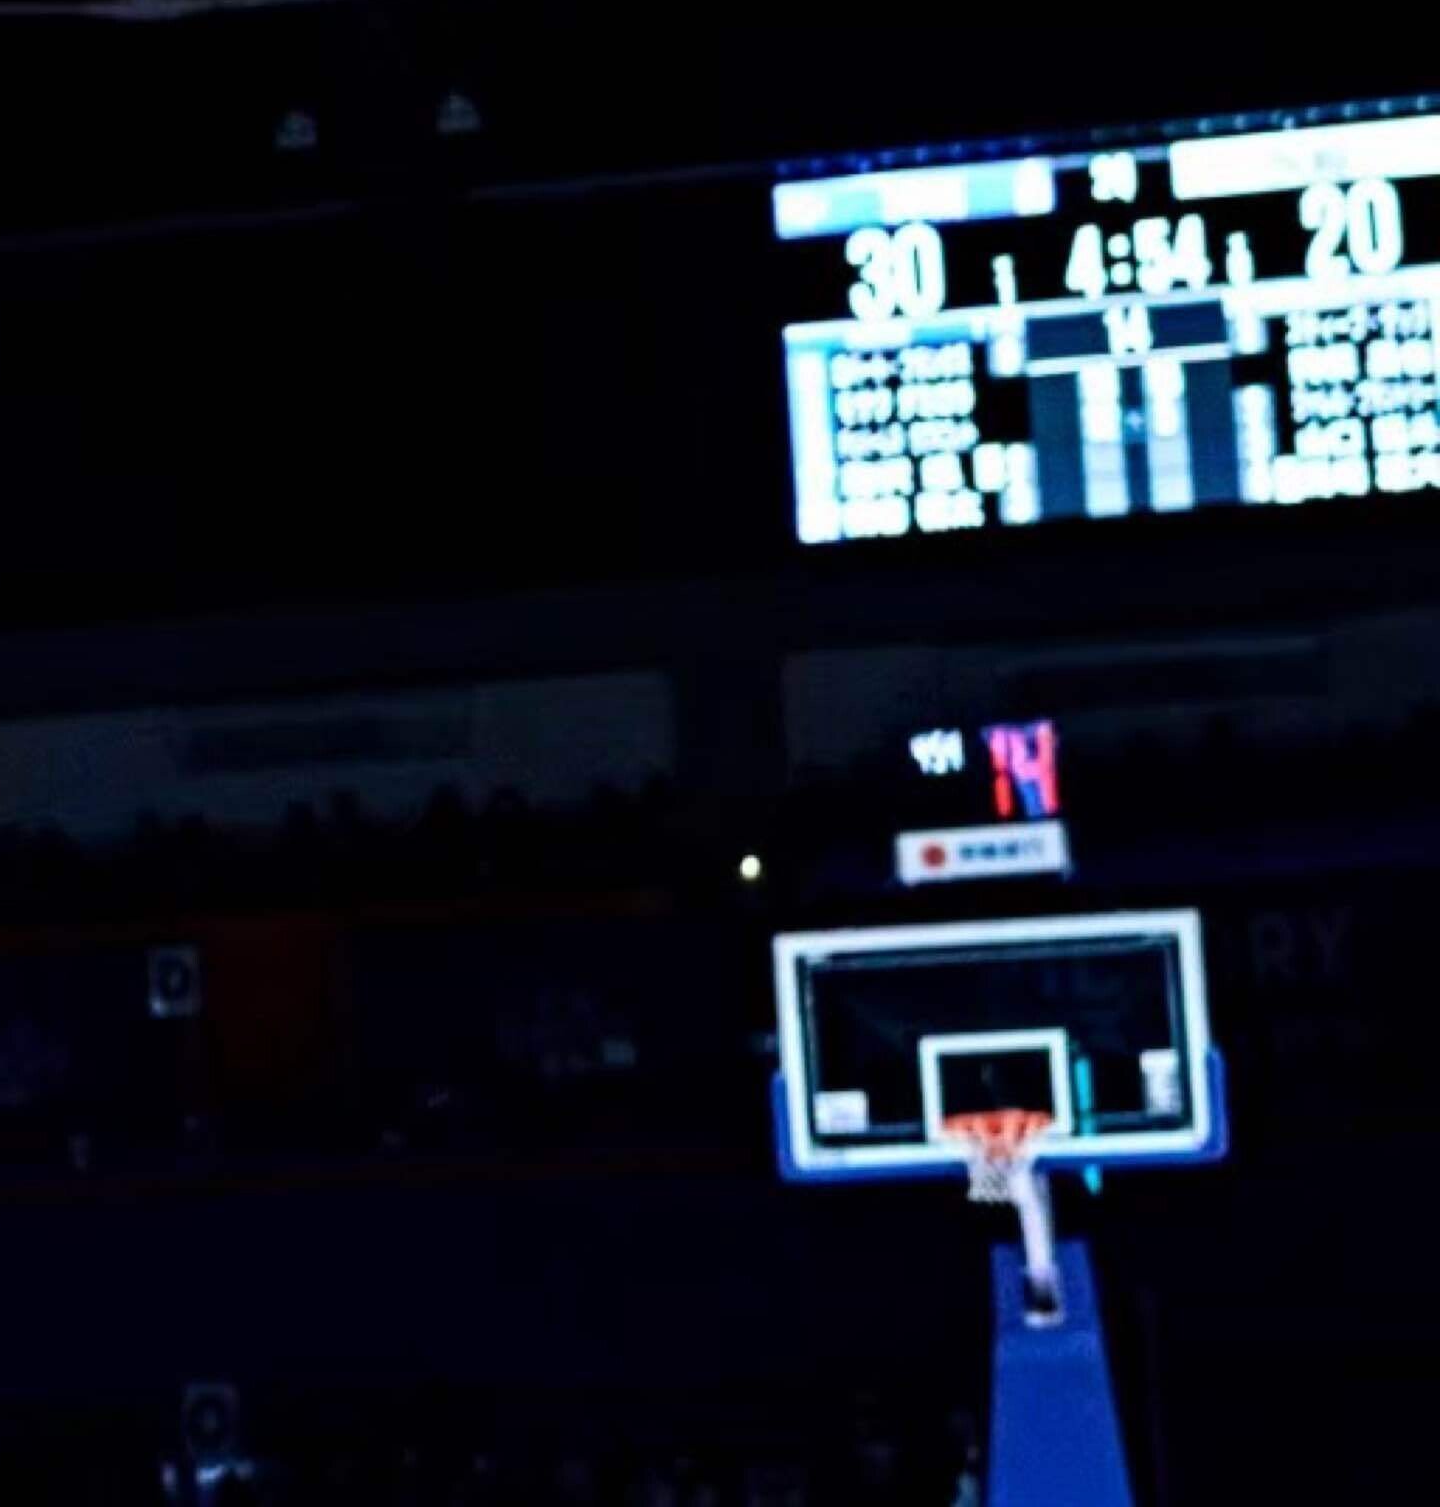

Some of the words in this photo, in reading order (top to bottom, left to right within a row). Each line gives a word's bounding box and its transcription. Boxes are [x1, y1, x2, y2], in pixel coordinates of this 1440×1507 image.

[846, 220, 944, 322] 30
[1067, 215, 1210, 300] 4:54
[1301, 179, 1401, 282] 20
